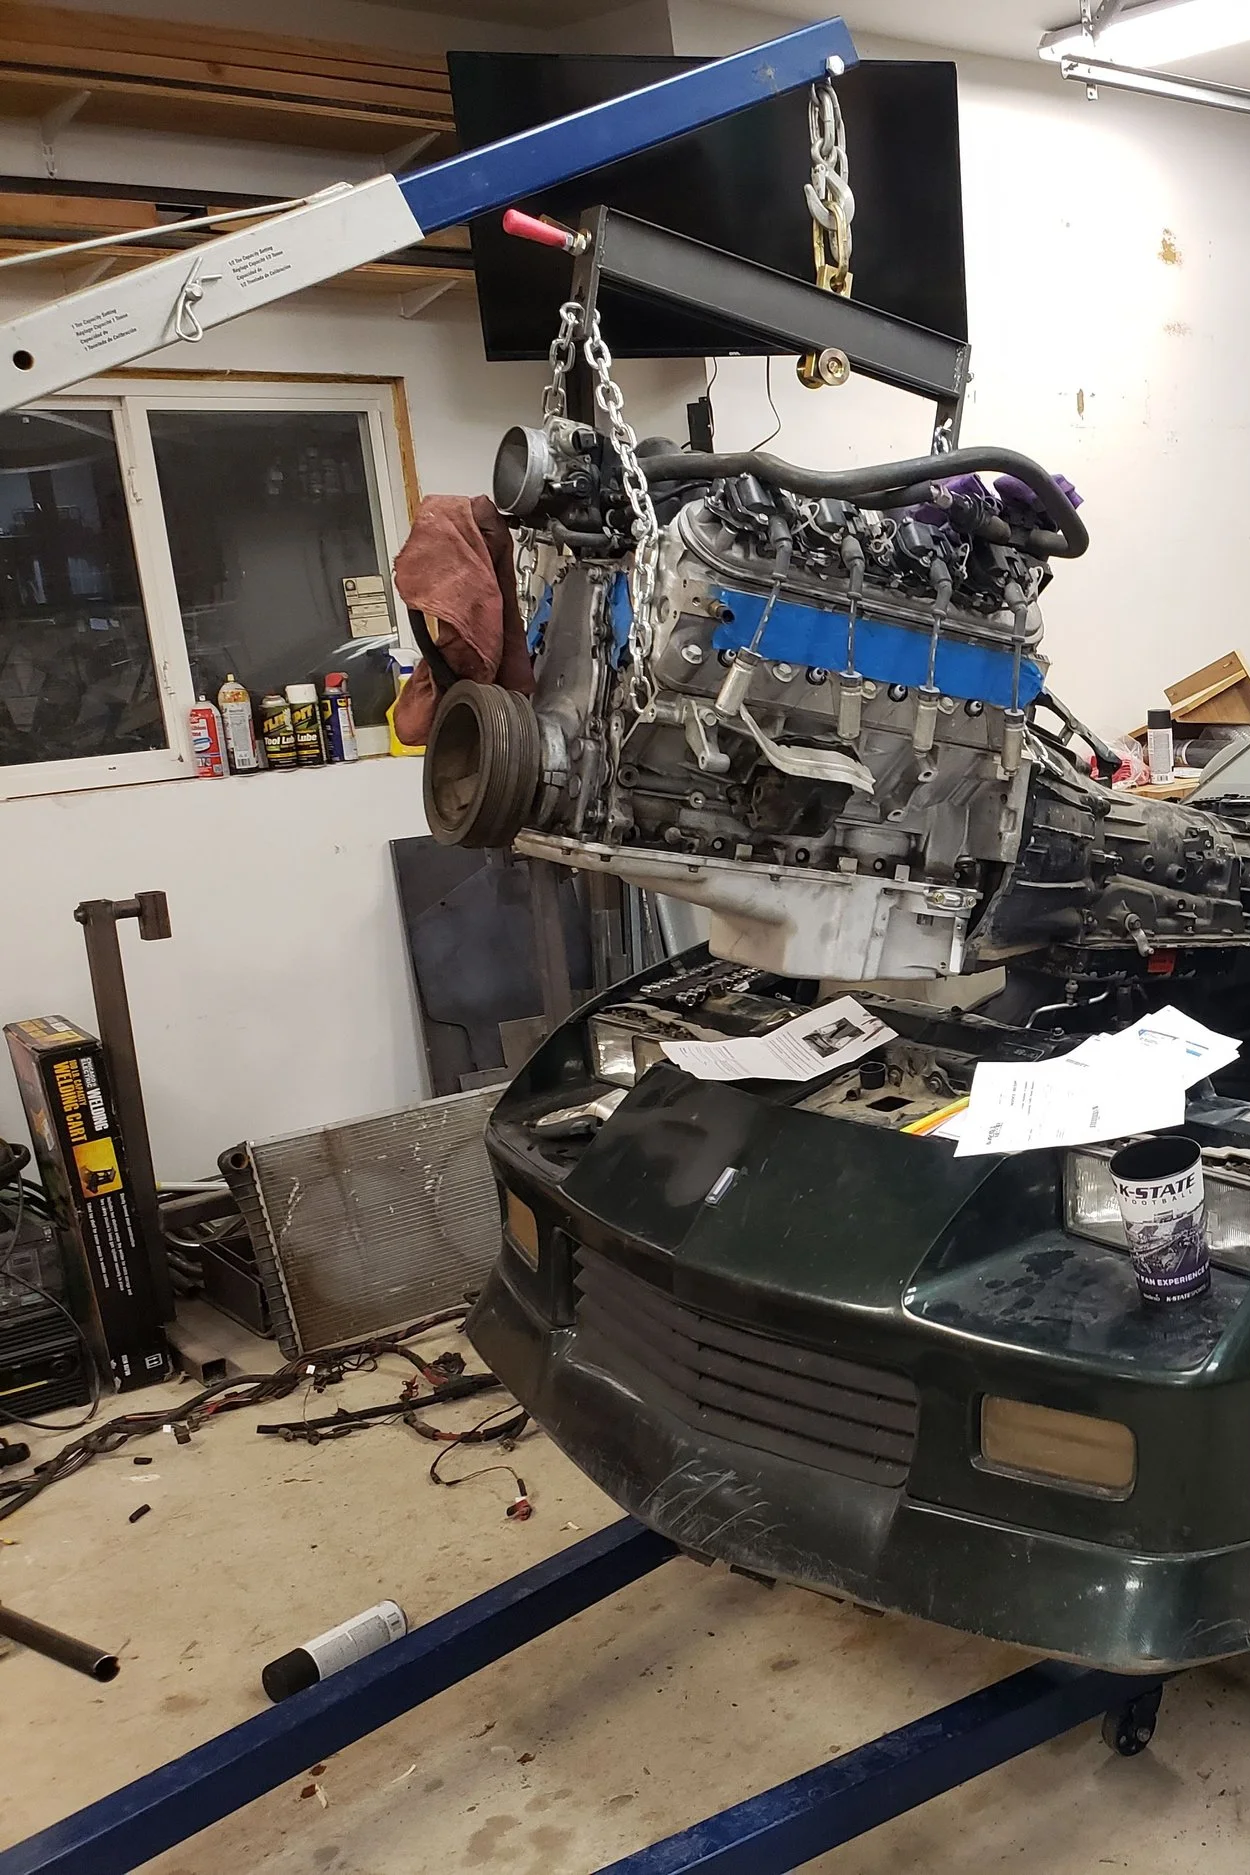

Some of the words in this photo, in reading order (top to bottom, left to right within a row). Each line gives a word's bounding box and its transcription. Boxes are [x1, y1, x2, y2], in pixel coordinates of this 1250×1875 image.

[264, 736, 281, 745] Tool
[297, 733, 317, 743] Lube
[53, 1061, 80, 1112] WELDING
[80, 1058, 93, 1088] ELECTRIC
[73, 1079, 87, 1106] CAPACITY
[86, 1087, 109, 1132] WELDING
[65, 1112, 88, 1143] CART
[1119, 1172, 1195, 1199] K-STATE
[1124, 1189, 1192, 1206] FOOTBALL
[1140, 1275, 1156, 1286] FAN
[1156, 1265, 1205, 1287] EXPERIENCE
